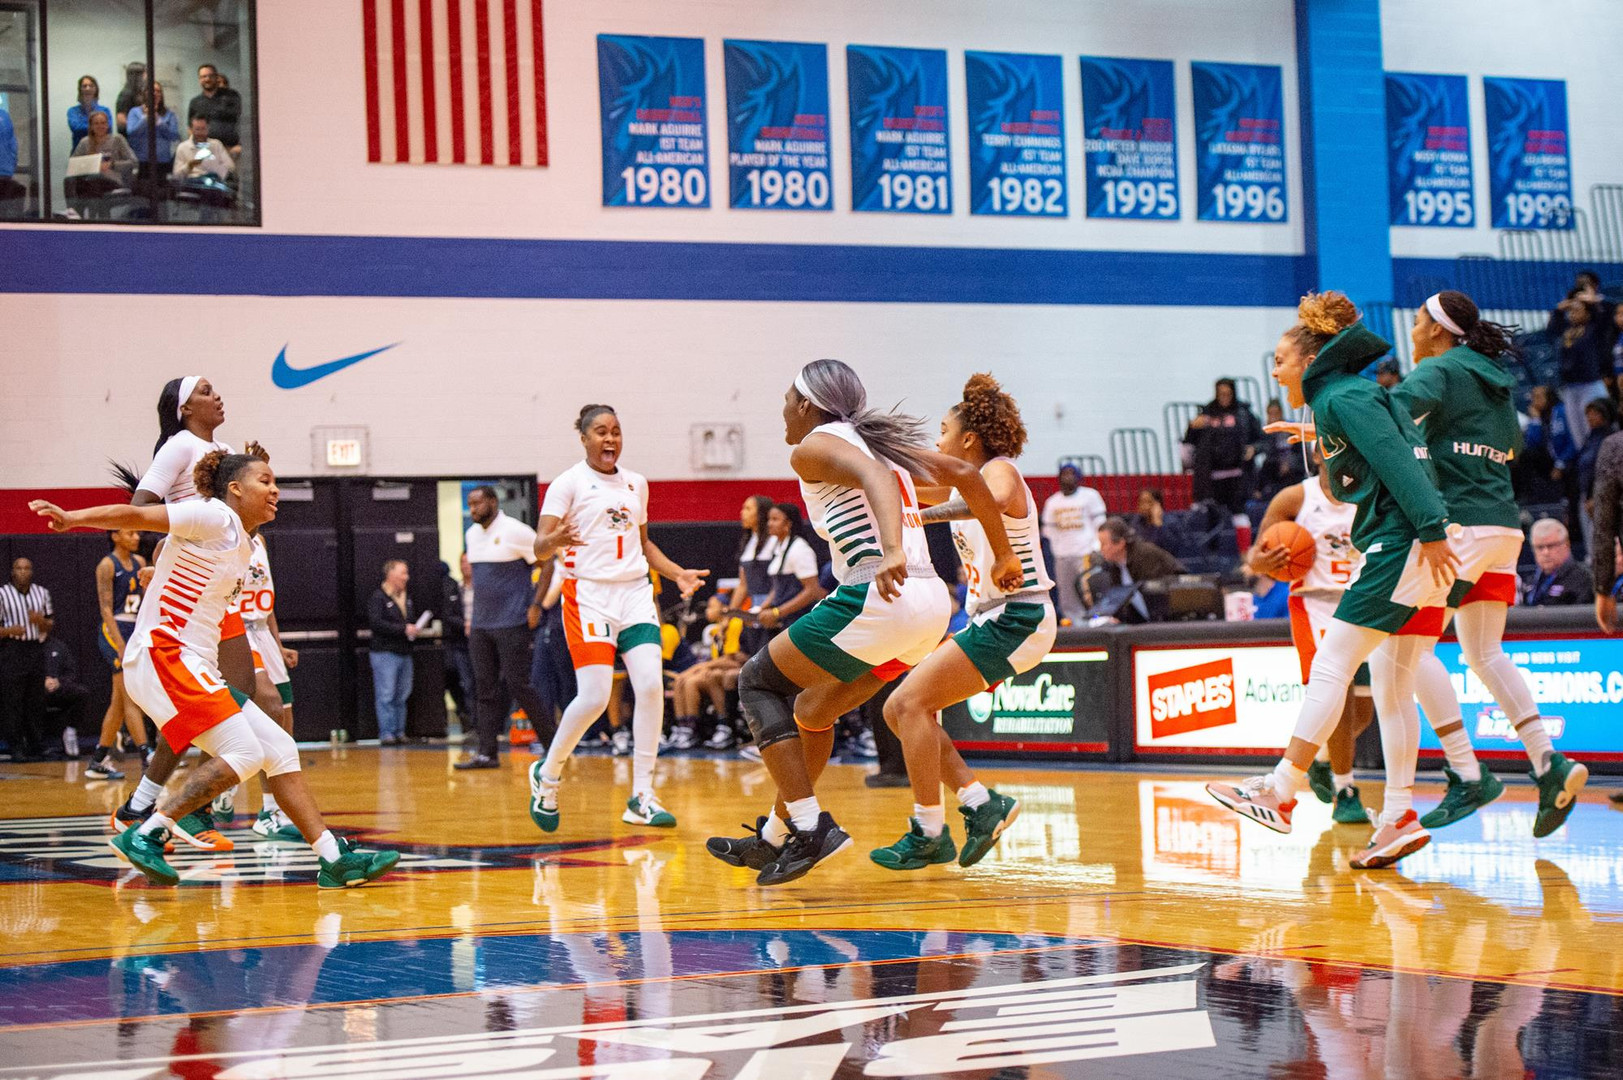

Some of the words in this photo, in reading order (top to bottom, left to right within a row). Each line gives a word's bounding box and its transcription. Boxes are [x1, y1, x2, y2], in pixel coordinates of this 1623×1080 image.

[628, 122, 658, 135] MARK
[659, 123, 703, 137] AGUIRRE
[677, 138, 703, 151] TEAM
[875, 130, 904, 143] MARK
[729, 152, 766, 167] PLAYER
[767, 154, 780, 167] OF
[781, 154, 800, 168] THE
[801, 155, 827, 169] YEAR
[754, 139, 783, 152] MARK
[784, 141, 826, 154] AGUIRRE
[621, 167, 706, 204] 1980
[747, 169, 829, 207] 1980
[878, 173, 948, 210] 1981
[987, 177, 1064, 213] 1982
[1102, 180, 1177, 216] 1995
[1212, 183, 1284, 220] 1996
[1404, 189, 1473, 225] 1995
[616, 535, 624, 559] 1
[1331, 560, 1352, 584] 5
[240, 590, 275, 613] 20
[1557, 651, 1581, 663] VISIT
[993, 672, 1076, 712] NovaCare
[1151, 673, 1233, 722] STAPLES
